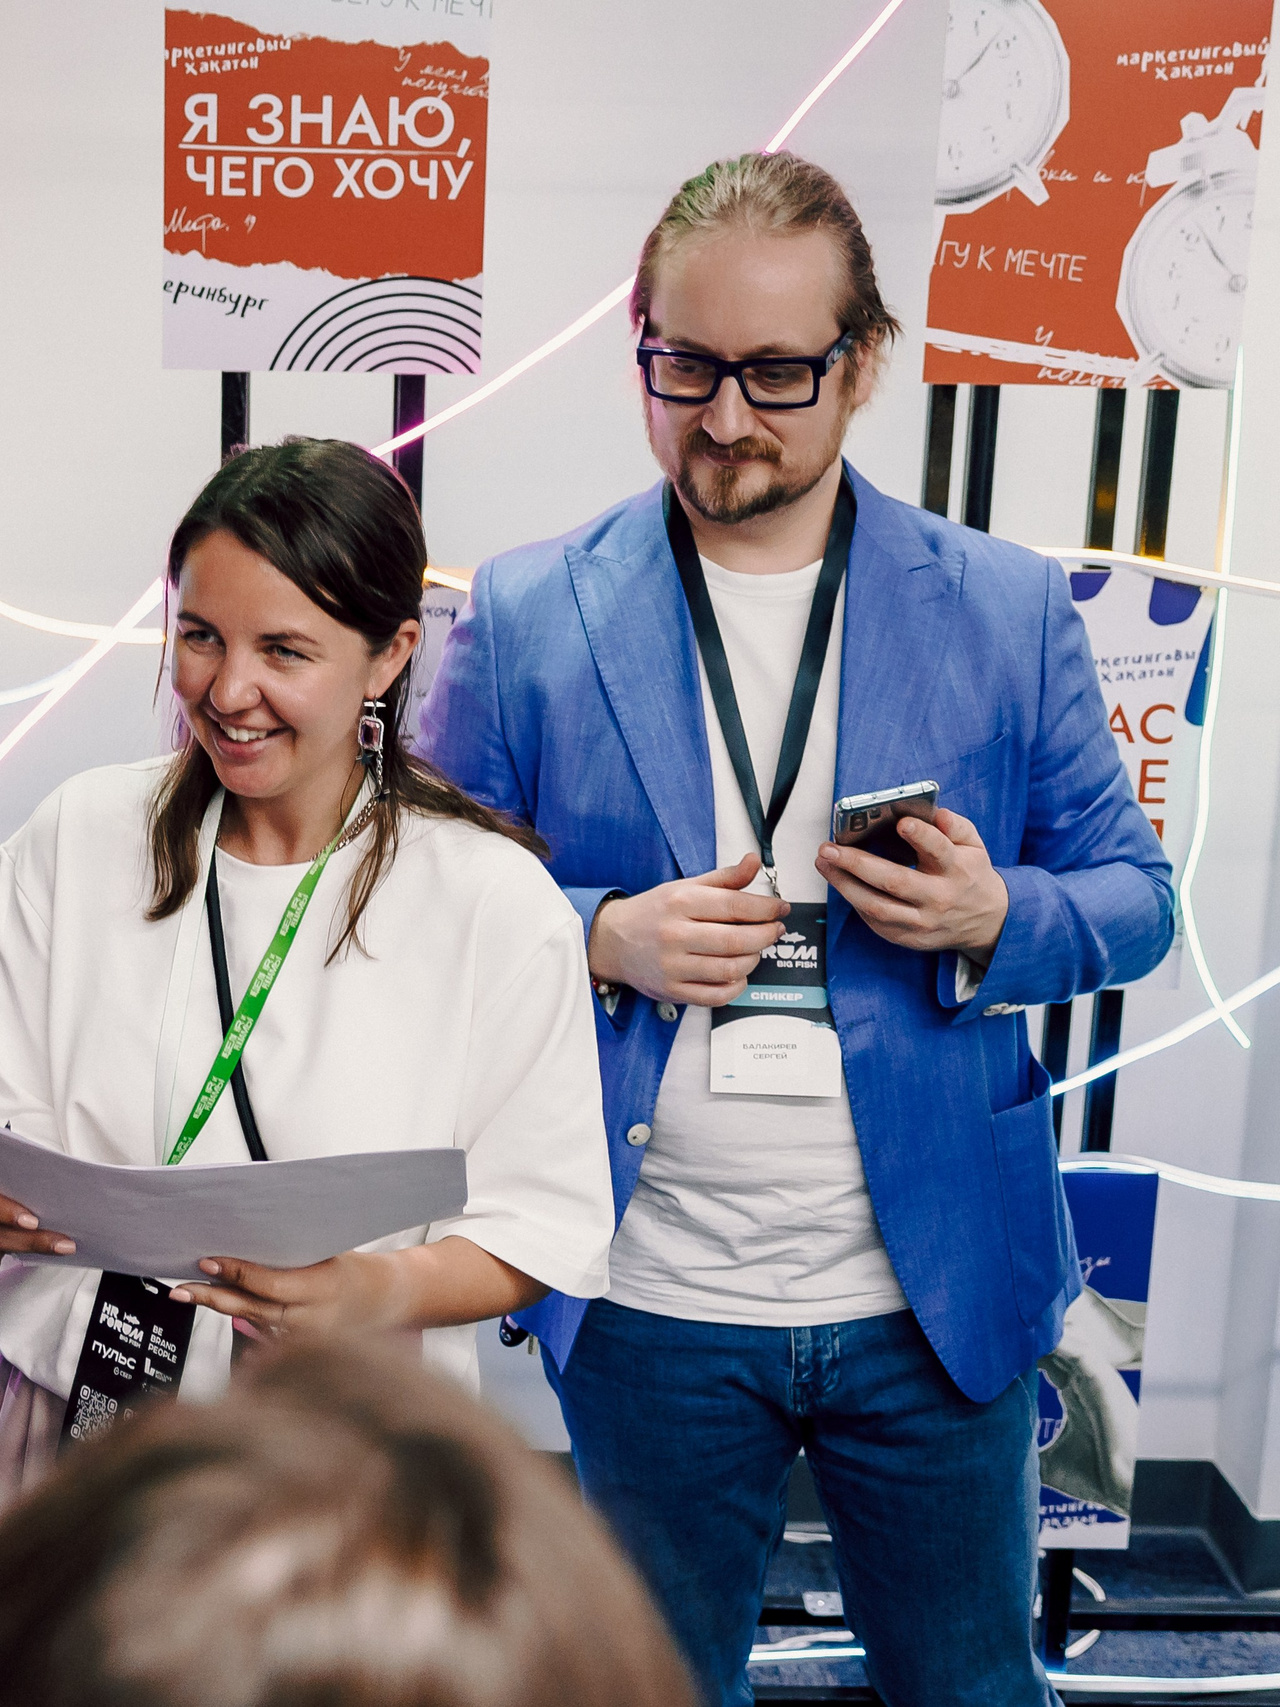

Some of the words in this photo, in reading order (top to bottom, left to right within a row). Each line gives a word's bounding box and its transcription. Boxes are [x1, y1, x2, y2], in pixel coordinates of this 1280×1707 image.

[1116, 36, 1270, 73] маркетинговый
[184, 56, 259, 76] хакатон
[1155, 61, 1235, 81] хакатон
[182, 93, 219, 144] Я
[245, 92, 472, 159] ЗНАЮ,
[186, 155, 315, 199] ЧЕГО
[332, 157, 475, 201] ХОЧУ
[939, 240, 971, 269] ГУ
[977, 244, 996, 272] К
[1004, 248, 1087, 283] МЕЧТЕ
[163, 280, 269, 318] еринбург
[1101, 667, 1175, 683] хакатон
[761, 944, 818, 960] RUM
[776, 960, 793, 968] BIG
[750, 991, 804, 1001] СПИКЕР
[742, 1042, 798, 1050] БАЛАКИРЕВ
[753, 1052, 788, 1060] СЕРГЕЙ
[102, 1301, 120, 1318] HR
[99, 1311, 144, 1343] FORUM
[152, 1324, 164, 1337] BE
[150, 1335, 177, 1353] BRAND
[147, 1344, 178, 1364] PEOPLE
